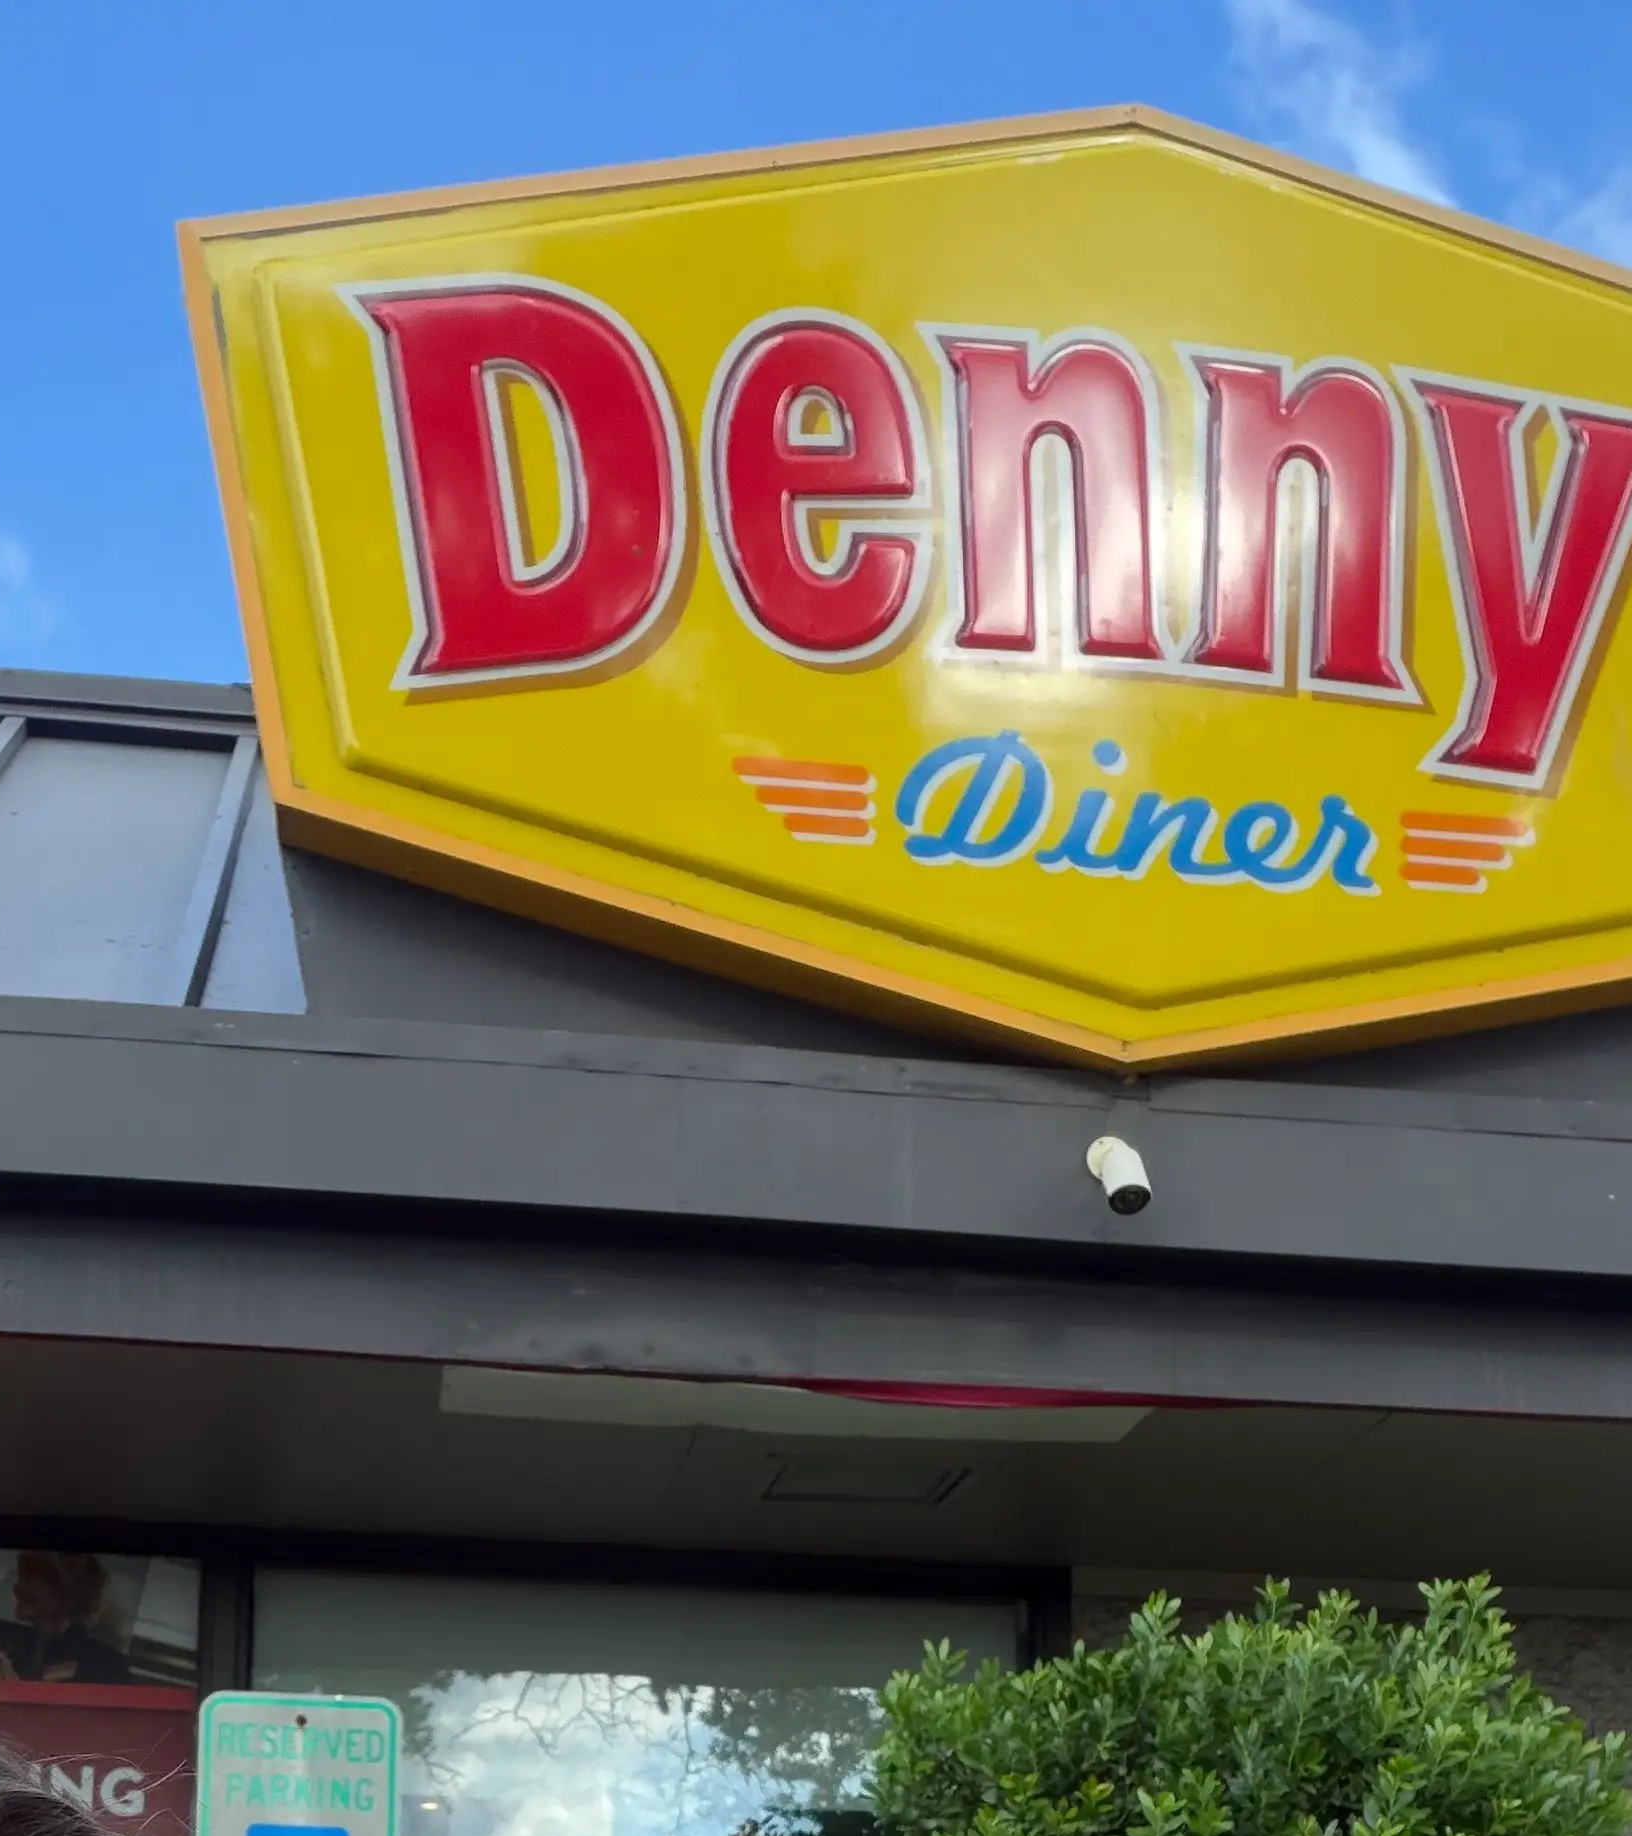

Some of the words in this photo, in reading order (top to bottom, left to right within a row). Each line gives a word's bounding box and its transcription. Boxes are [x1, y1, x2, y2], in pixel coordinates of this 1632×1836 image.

[894, 730, 1382, 894] Diner
[217, 1722, 386, 1764] RESERVED
[224, 1773, 376, 1812] PARKING
